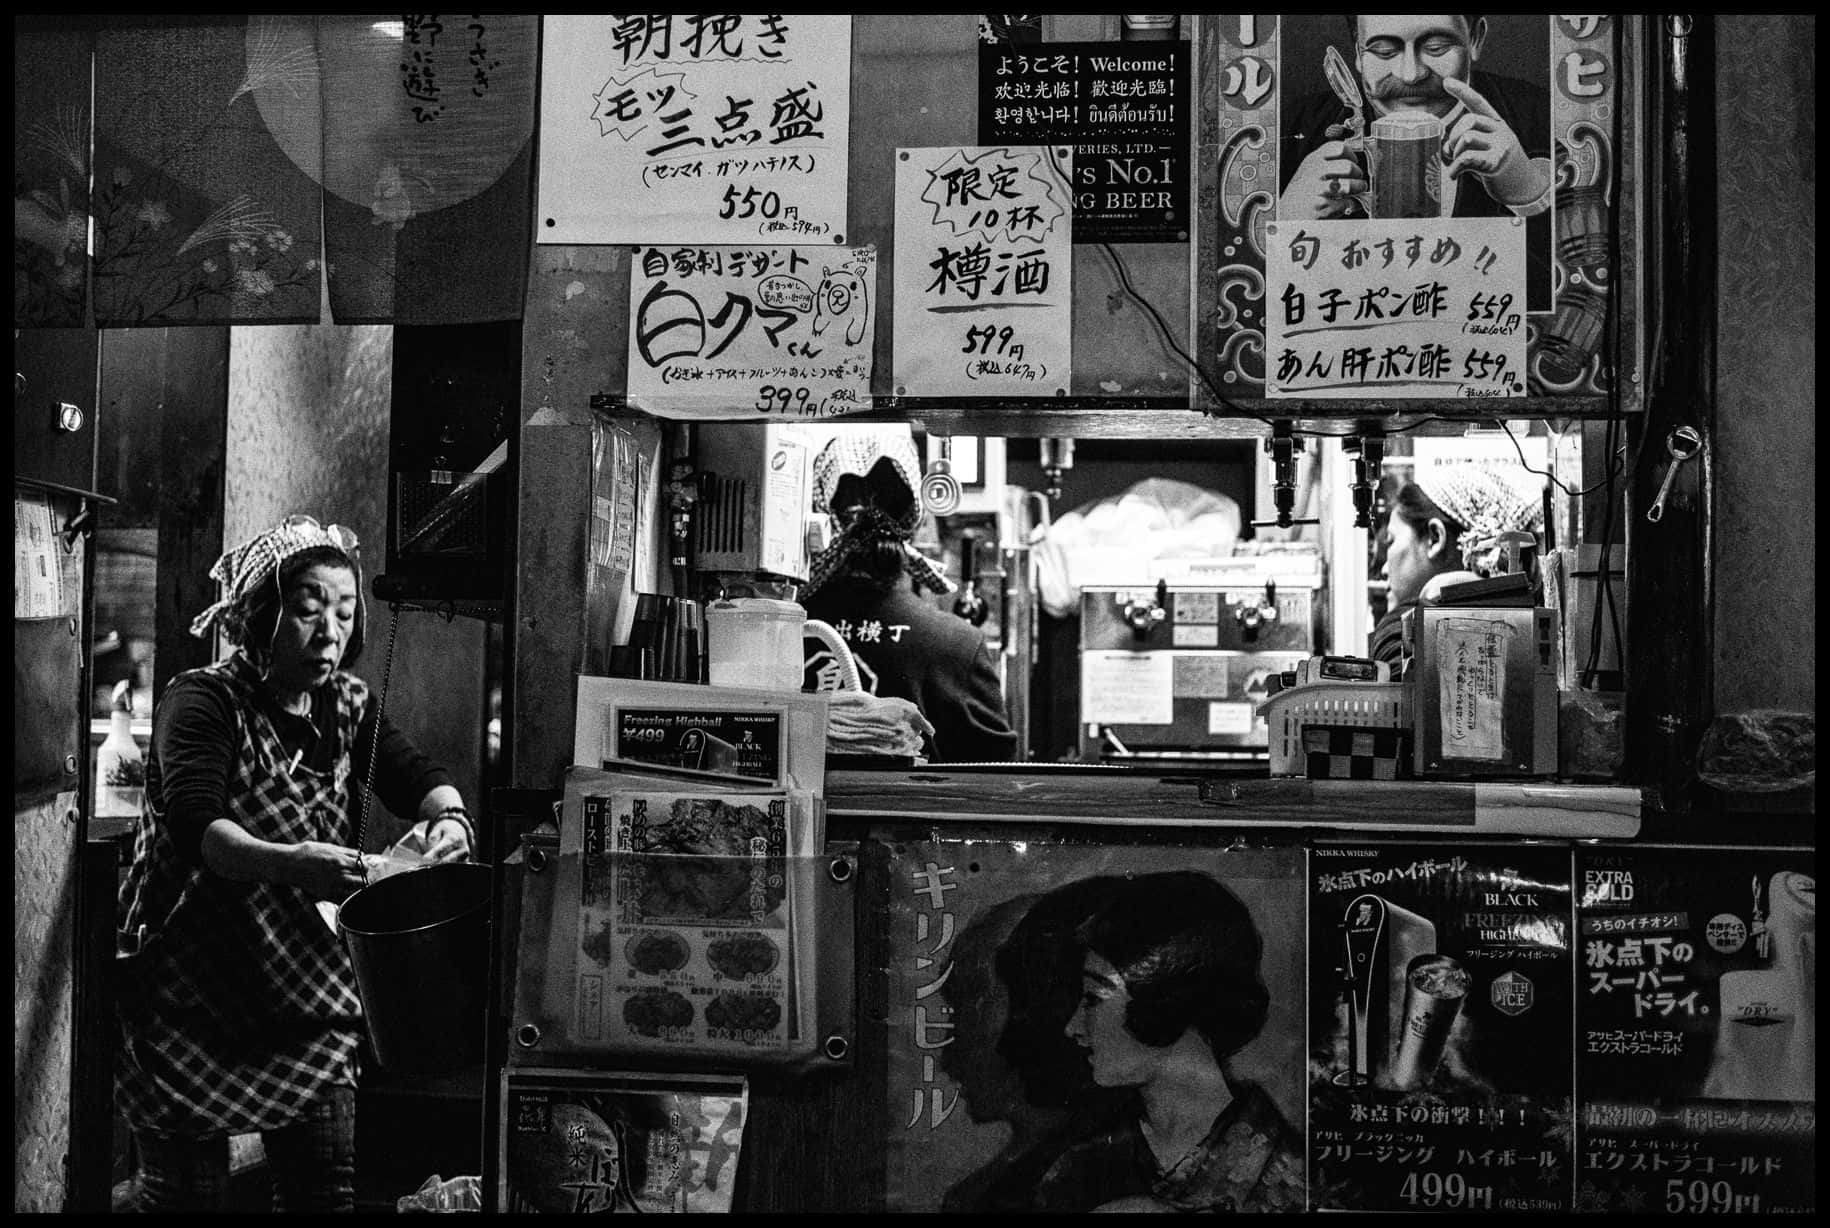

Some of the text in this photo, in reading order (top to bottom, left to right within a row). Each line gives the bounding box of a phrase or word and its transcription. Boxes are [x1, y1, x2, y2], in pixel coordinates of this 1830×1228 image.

[612, 15, 790, 65] 朝挽き
[995, 55, 1080, 75] ようこそ!
[1089, 54, 1175, 72] Welcome!
[994, 79, 1080, 100] 欢迎光临!
[1091, 78, 1175, 98] 歡迎光臨!
[604, 85, 676, 122] モツ
[994, 106, 1080, 125] 환영합니다!
[646, 81, 825, 156] 三点盛
[1073, 144, 1123, 156] ERIES,
[1106, 158, 1174, 186] No.1
[940, 165, 1023, 207] 限定
[719, 184, 799, 220] 550円
[1106, 191, 1174, 209] BEER
[968, 205, 1045, 231] 10杯
[1288, 229, 1321, 270] 旬
[925, 242, 1050, 300] 樽酒
[1280, 281, 1521, 330] 白子ポン酢 559円
[962, 325, 1024, 361] 599円
[1276, 344, 1516, 386] あん肝ポン酢 559円
[755, 385, 818, 416] 399円
[623, 714, 723, 728] Freezing Highball
[622, 728, 665, 743] ¥499
[1316, 849, 1346, 857] NIKKA
[1318, 856, 1468, 893] 氷点下のハイボール
[1585, 870, 1633, 885] EXTRA
[1485, 893, 1539, 907] BLACK
[1591, 916, 1678, 932] うちのイチオシ!
[1585, 937, 1694, 968] 氷点下の
[1589, 967, 1685, 994] スーパー
[907, 862, 959, 1130] キリンビール
[1501, 993, 1526, 1006] ICE
[1634, 991, 1710, 1018] ドライ。
[1587, 1030, 1684, 1043] アサヒスーパードライ
[1587, 1041, 1684, 1055] エクストラコールド
[1315, 1145, 1558, 1168] フリージング ハイボール
[1584, 1151, 1783, 1176] エクストラコールド
[1399, 1172, 1494, 1210] 499円
[1665, 1178, 1761, 1215] 599円
